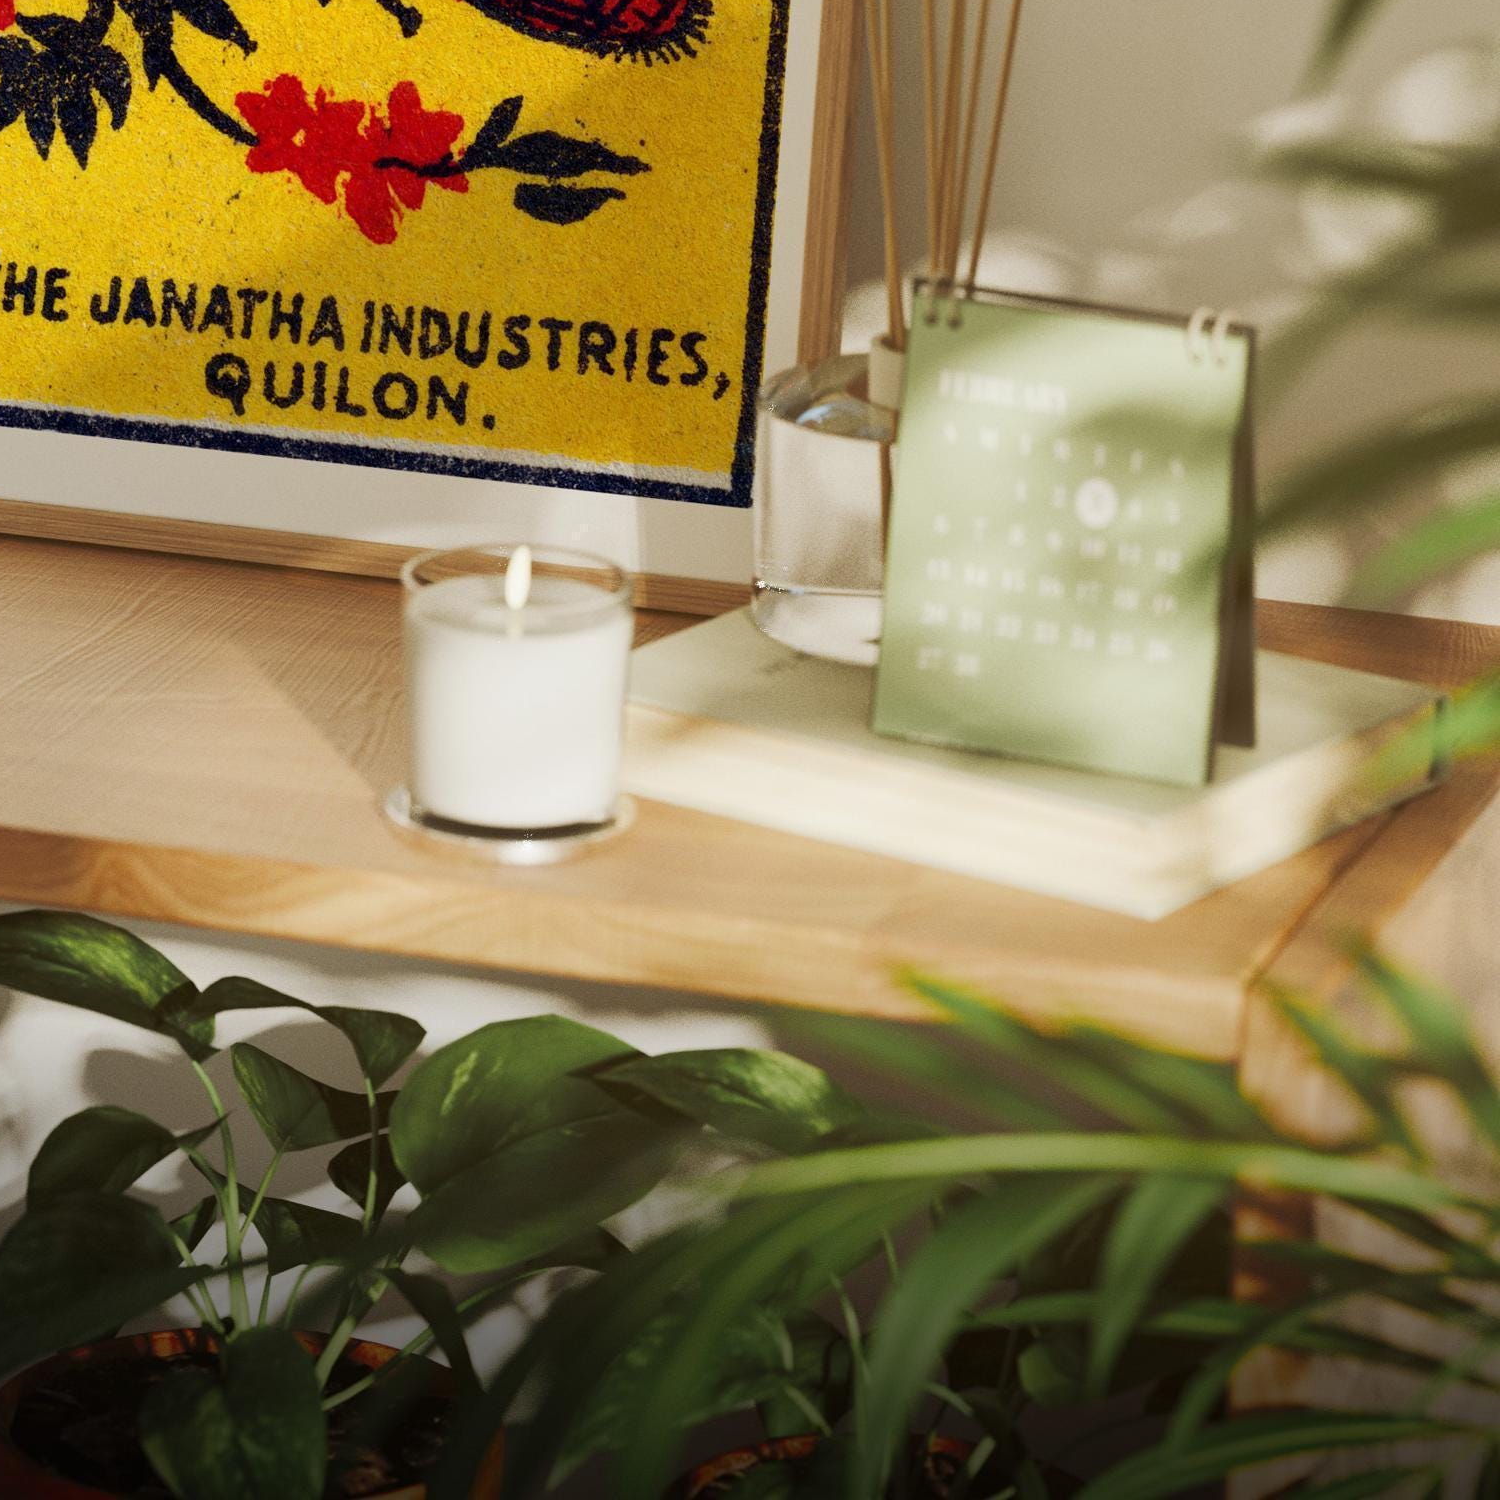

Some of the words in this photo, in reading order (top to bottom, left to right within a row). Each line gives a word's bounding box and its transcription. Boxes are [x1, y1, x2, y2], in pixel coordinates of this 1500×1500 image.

[89, 275, 345, 352] JANATHA
[360, 300, 730, 400] INDUSTRIES,
[204, 352, 496, 431] QUILON.
